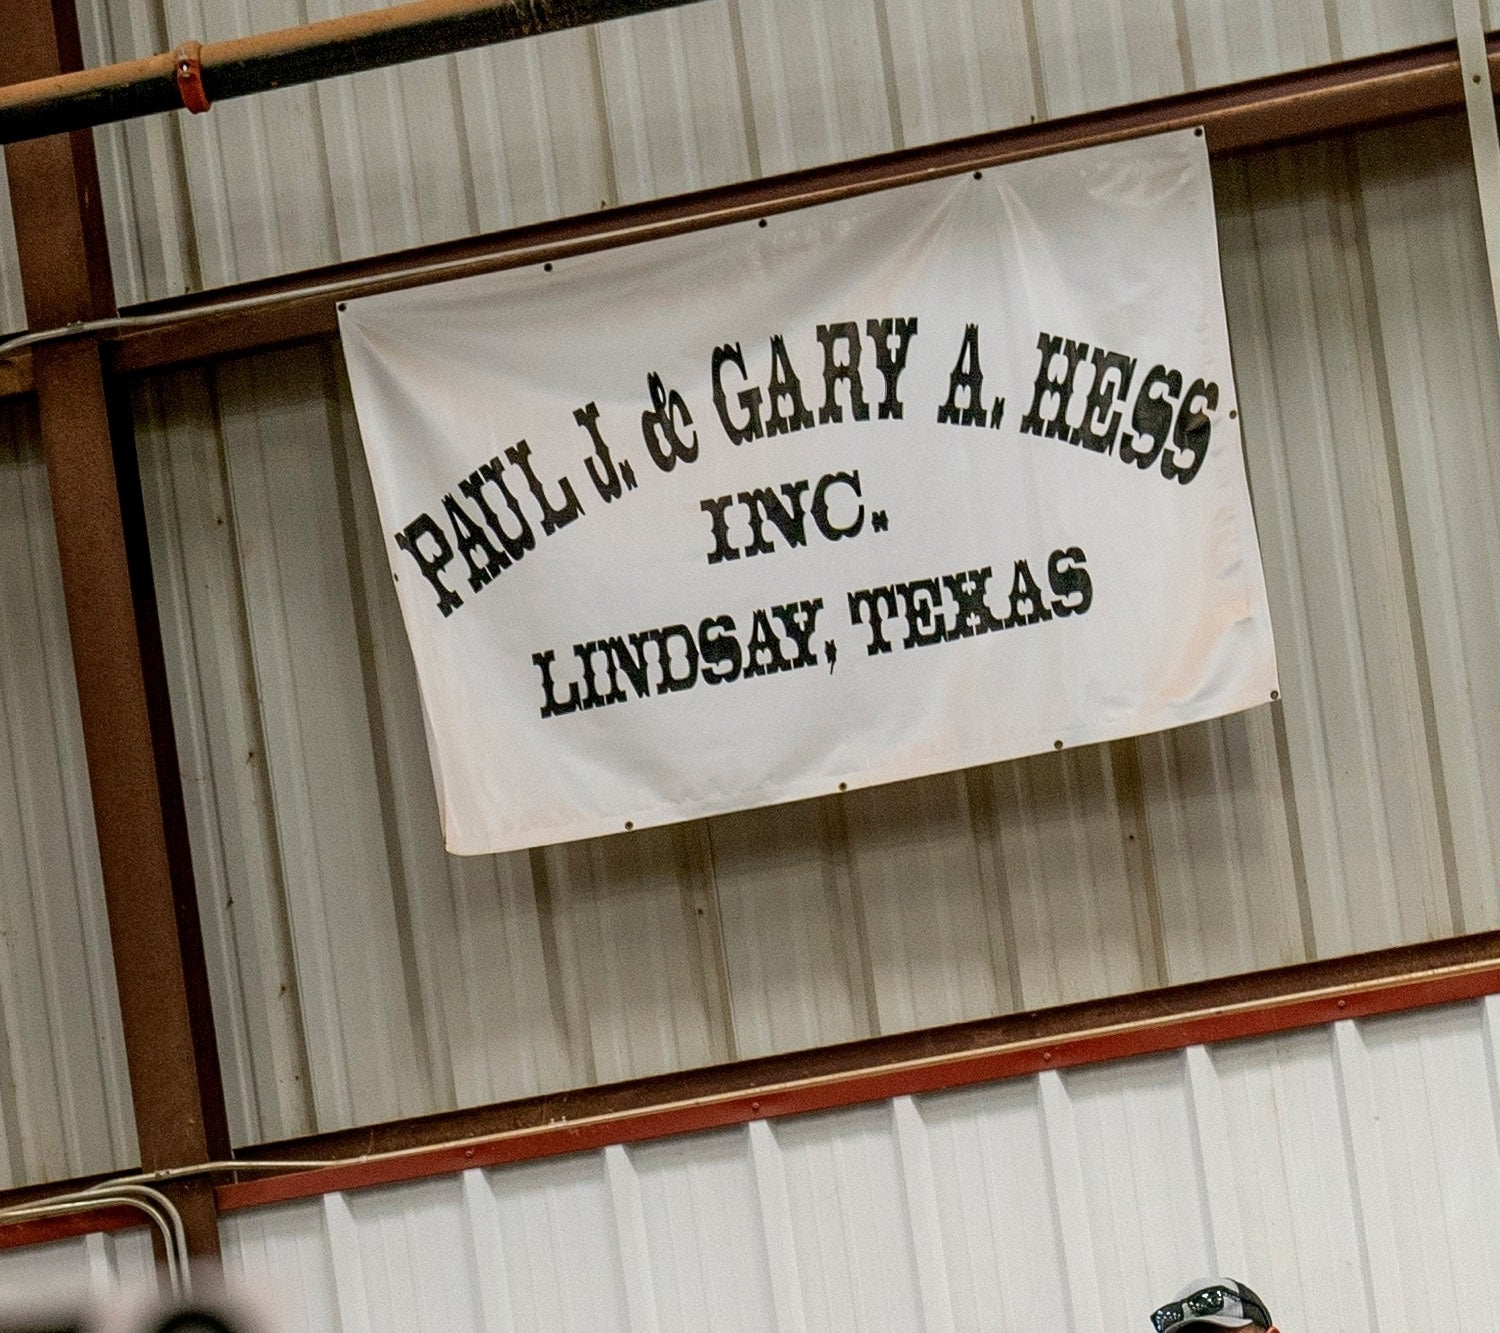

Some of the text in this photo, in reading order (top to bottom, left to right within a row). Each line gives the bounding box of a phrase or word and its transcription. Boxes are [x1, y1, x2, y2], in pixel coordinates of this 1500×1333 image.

[394, 316, 1220, 617] PAUL J. & GARY A. HESS
[701, 469, 890, 565] INC.
[531, 546, 1094, 719] LINDSAY, TEXAS
